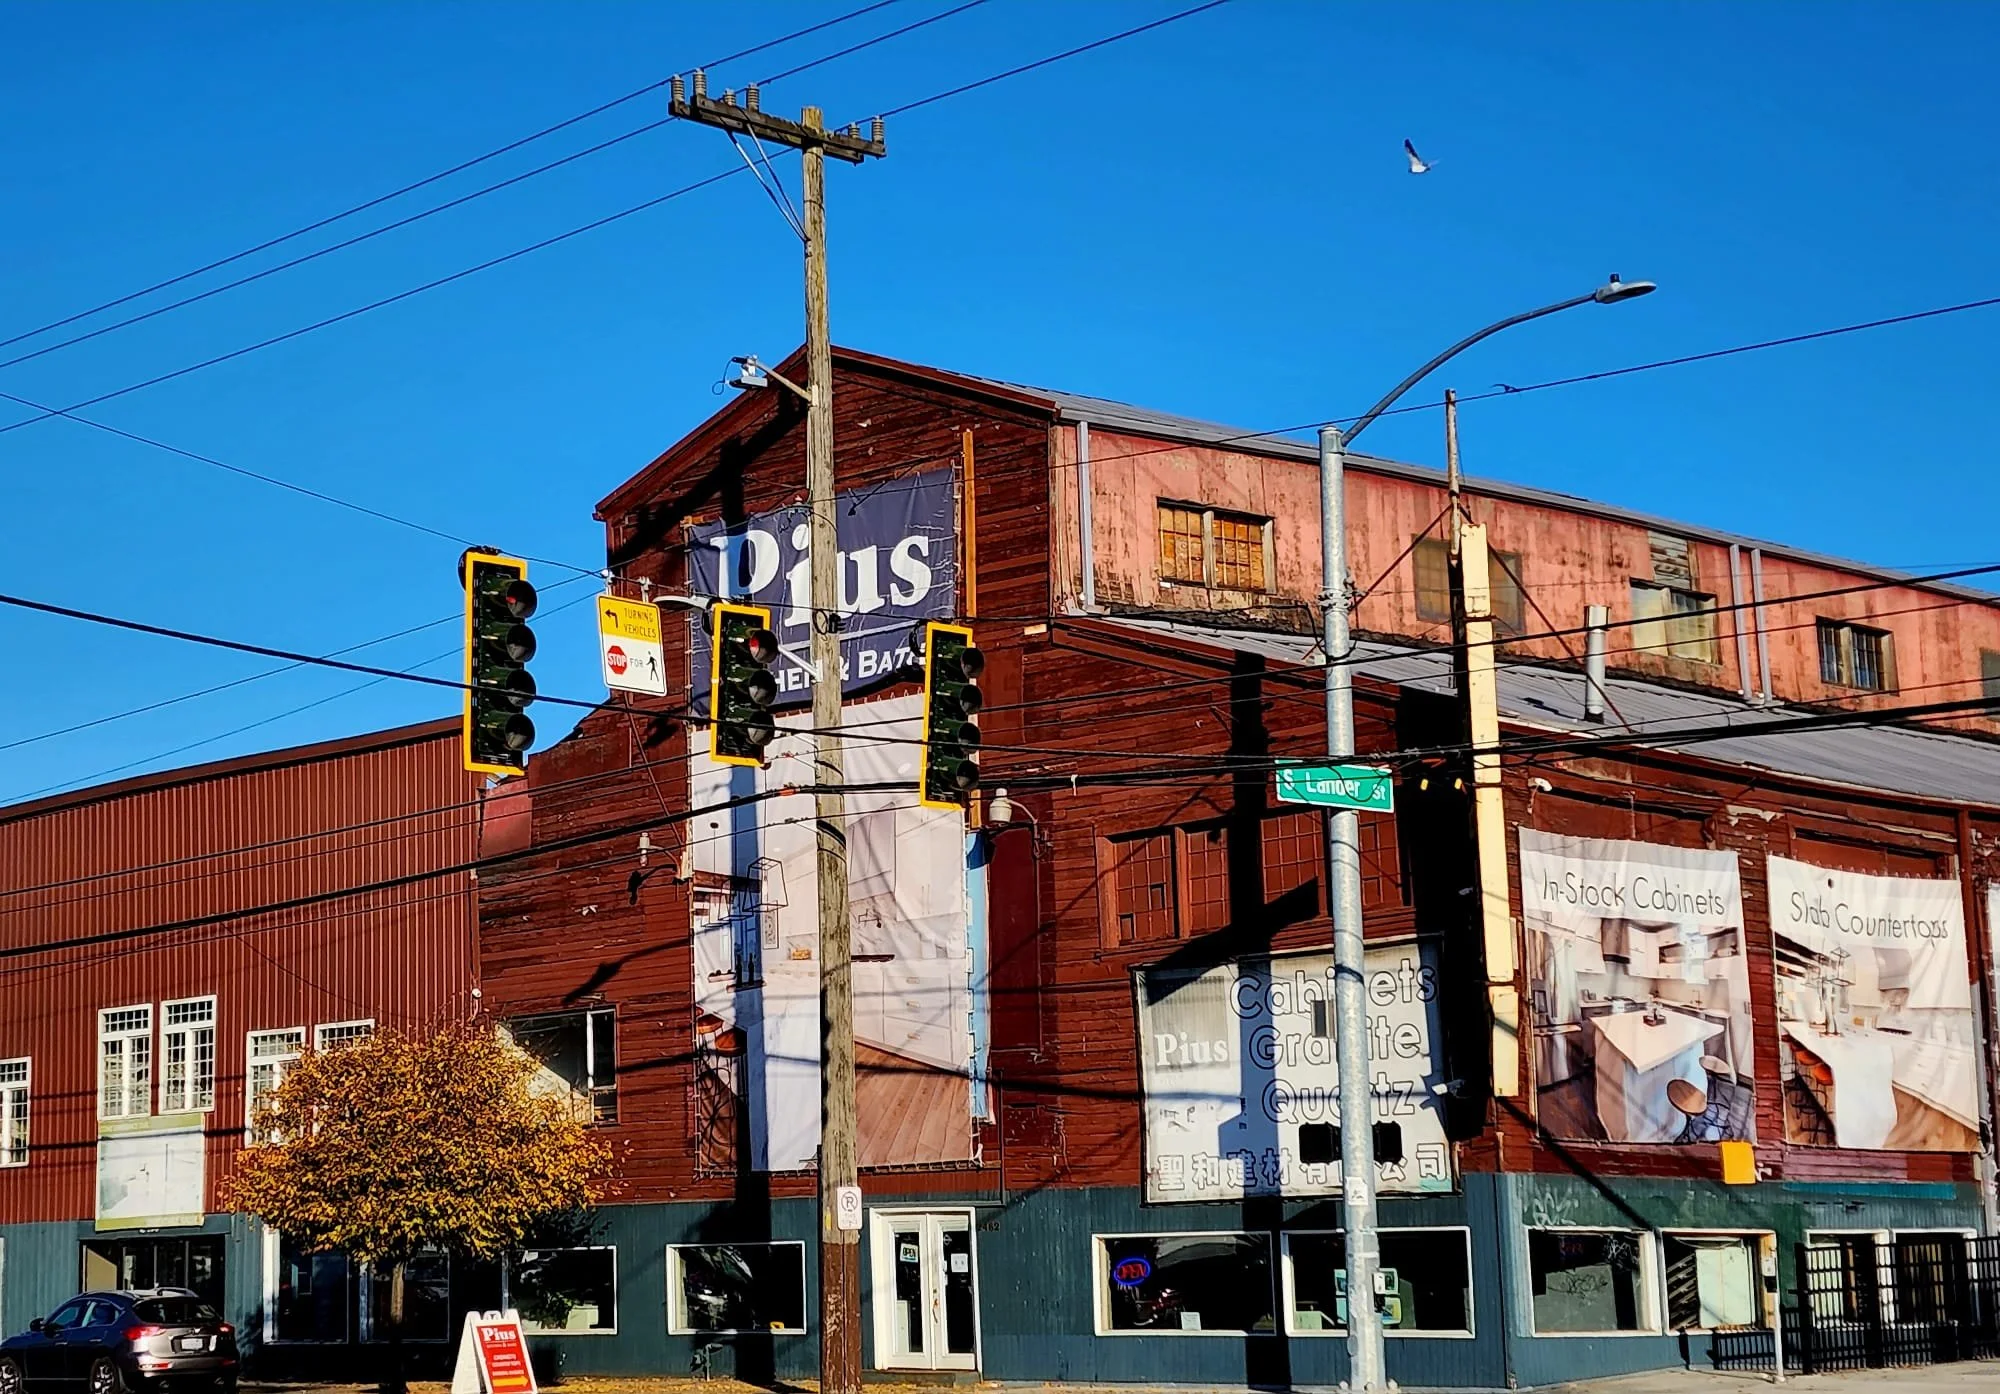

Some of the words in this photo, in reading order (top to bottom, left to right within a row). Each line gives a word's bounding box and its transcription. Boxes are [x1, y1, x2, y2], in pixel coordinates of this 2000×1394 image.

[710, 524, 932, 628] Pius
[624, 608, 653, 623] TURNING
[624, 624, 656, 638] VEHICLES
[608, 653, 627, 667] STOP
[630, 657, 644, 667] FOR
[1283, 769, 1295, 790] S
[1305, 771, 1360, 797] Lander
[1372, 783, 1386, 800] St
[1543, 868, 1625, 908] In-Stock
[1633, 876, 1725, 916] Cabinets
[1791, 891, 1830, 929] Slab
[1834, 903, 1949, 950] Countertops
[1229, 958, 1436, 1019] Cabiets
[1154, 1031, 1229, 1067] Pius
[1249, 1015, 1422, 1070] Graite
[1116, 1263, 1147, 1280] OPEN
[482, 1327, 516, 1341] Pius
